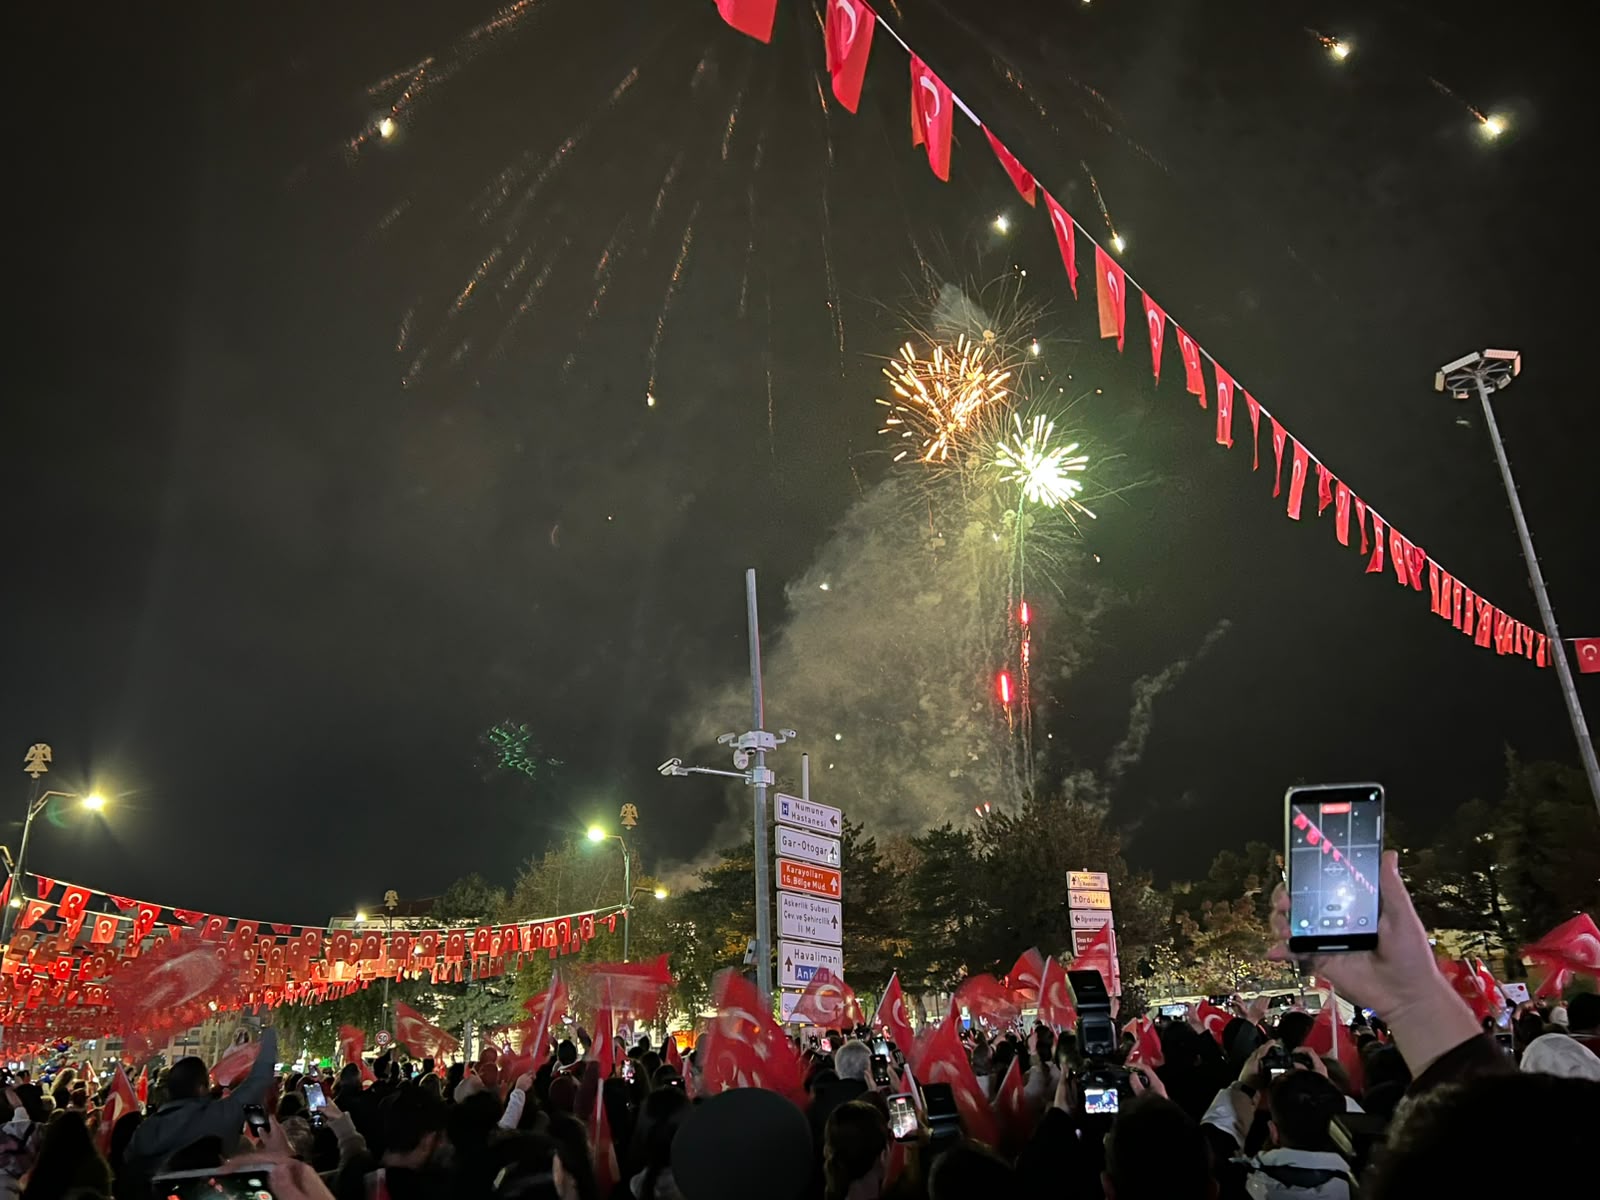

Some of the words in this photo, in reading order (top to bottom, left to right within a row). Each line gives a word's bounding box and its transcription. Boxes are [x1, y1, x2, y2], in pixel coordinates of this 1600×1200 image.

[796, 802, 824, 816] Numune
[792, 812, 826, 828] Hastanesi
[782, 836, 828, 855] Gar-Otogar
[786, 864, 824, 879] Karayolları
[783, 874, 792, 884] 16.
[794, 876, 810, 888] Bölge
[812, 880, 826, 890] Müd.
[784, 898, 808, 910] Askerlik
[810, 904, 830, 914] Şubesi
[804, 914, 830, 925] Şehircilik
[806, 926, 816, 935] Md
[794, 949, 840, 964] Havalimanı
